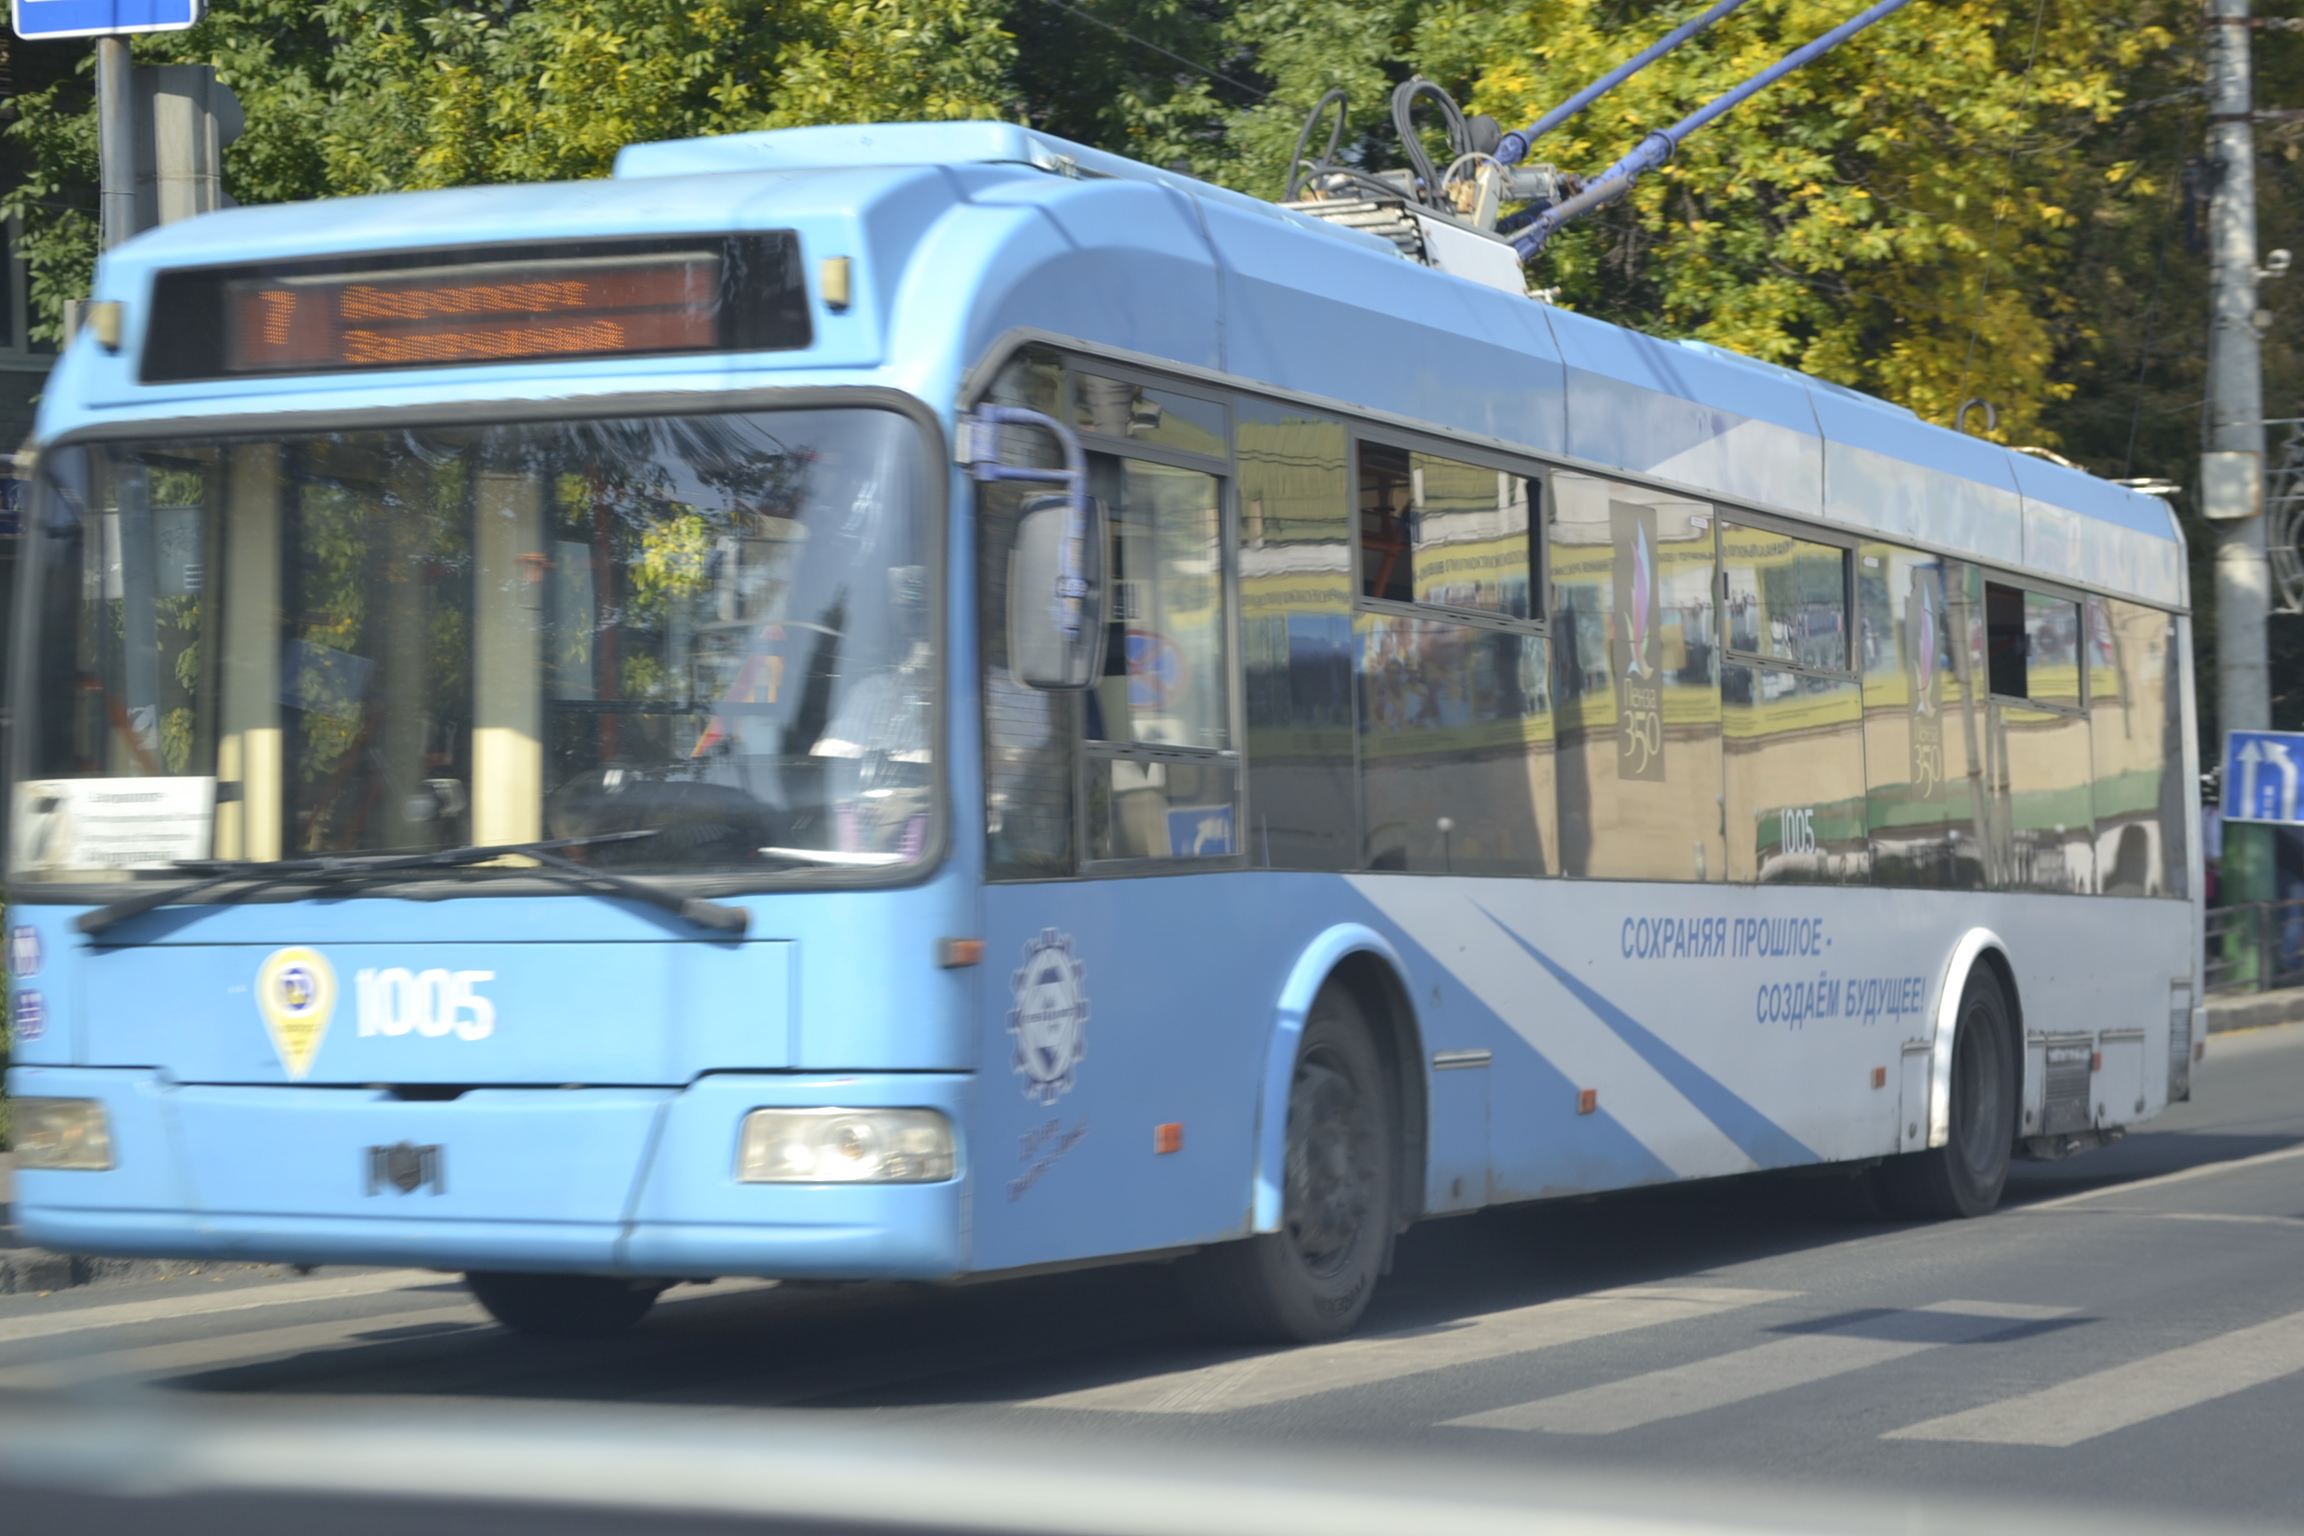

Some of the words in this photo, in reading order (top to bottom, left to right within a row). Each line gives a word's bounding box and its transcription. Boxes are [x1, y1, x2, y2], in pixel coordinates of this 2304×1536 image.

[1622, 709, 1661, 775] 350
[1913, 743, 1942, 800] 350
[1780, 808, 1816, 856] 1005
[1621, 916, 1727, 959] СОХРАНЯЯ
[353, 966, 497, 1042] 1005
[1756, 970, 1840, 1031] СОЗДАЁМ
[1845, 976, 1926, 1026] БУДУЩЕЕ!
